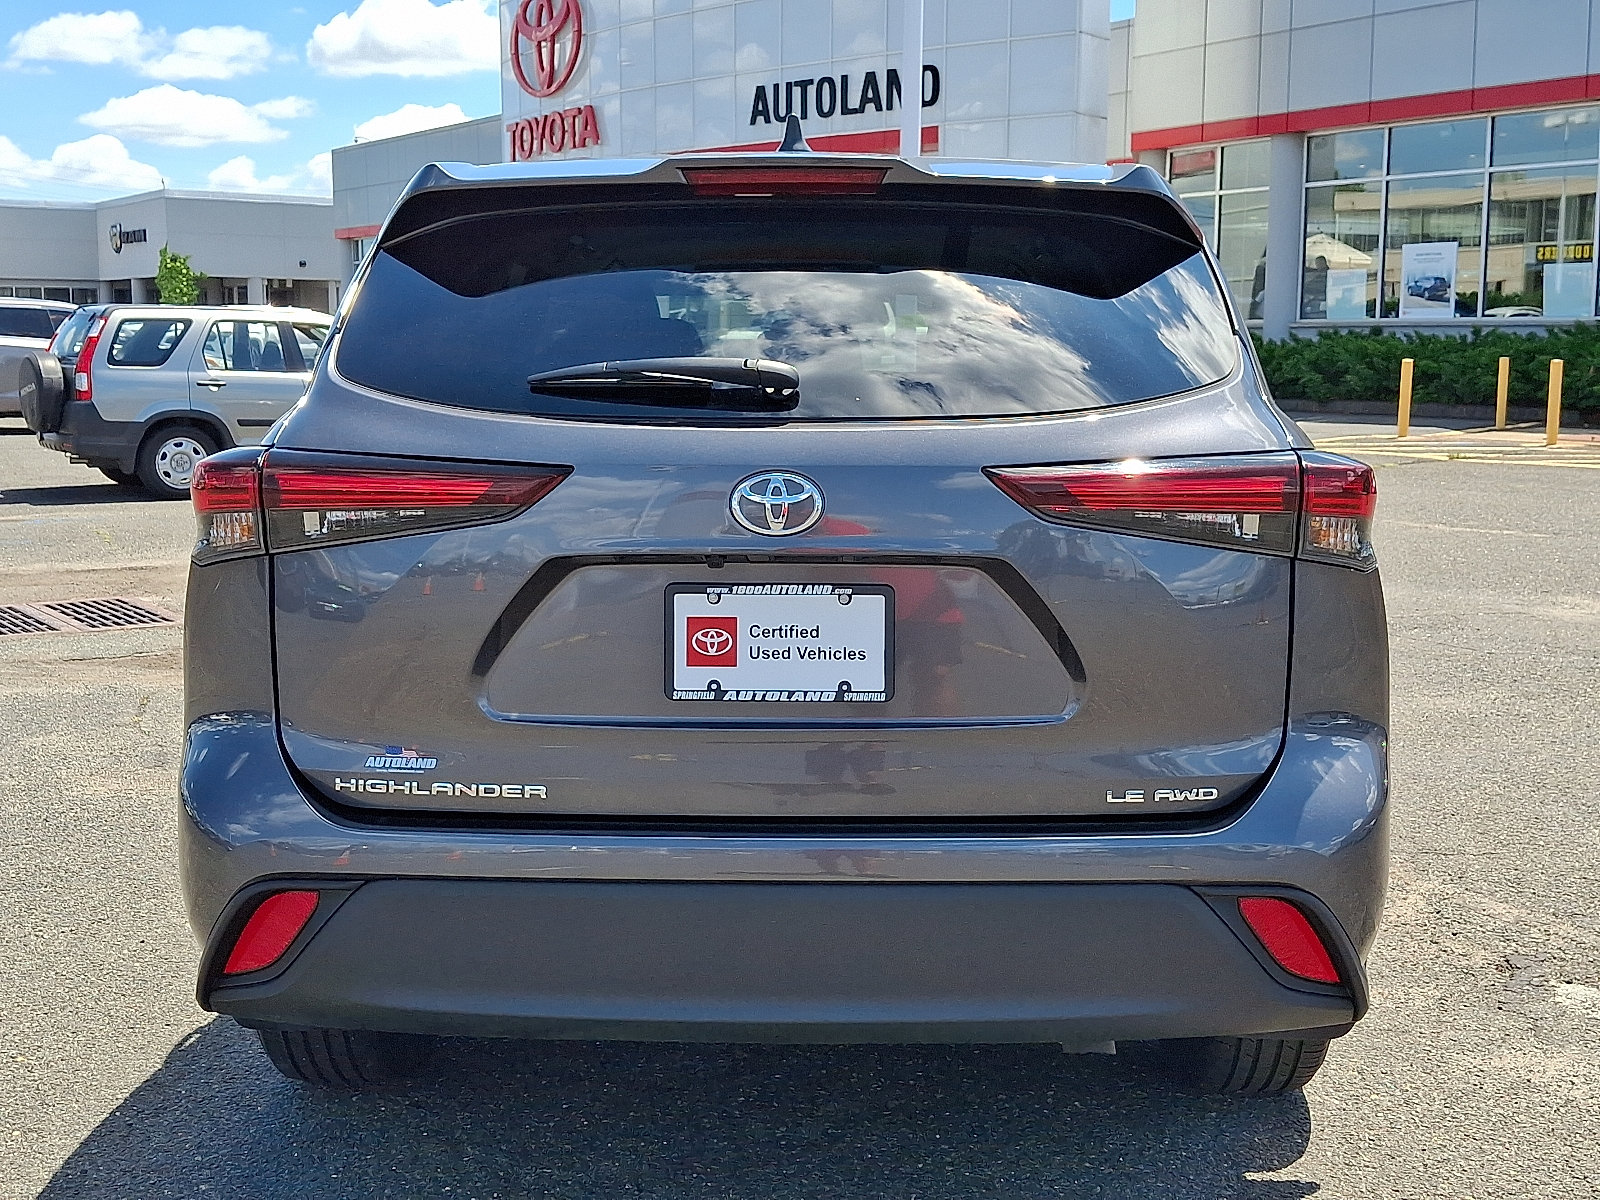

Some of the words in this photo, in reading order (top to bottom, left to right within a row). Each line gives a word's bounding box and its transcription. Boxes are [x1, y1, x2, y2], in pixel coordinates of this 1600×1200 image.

[749, 64, 941, 126] AUTOLAND
[505, 104, 601, 162] TOYOTA
[706, 584, 853, 595] www.1800AUTOLAND.com
[749, 624, 820, 639] Certified
[749, 645, 791, 660] Used
[797, 646, 867, 661] Vehicles
[672, 690, 716, 700] SPRINGFIELD
[722, 690, 837, 702] AUTOLAND
[843, 691, 886, 702] SPRINGFIELD
[364, 756, 438, 769] AUTOLAND
[334, 777, 548, 799] HIGHLANDER
[1106, 789, 1145, 803] LE
[1154, 787, 1219, 802] AWD
